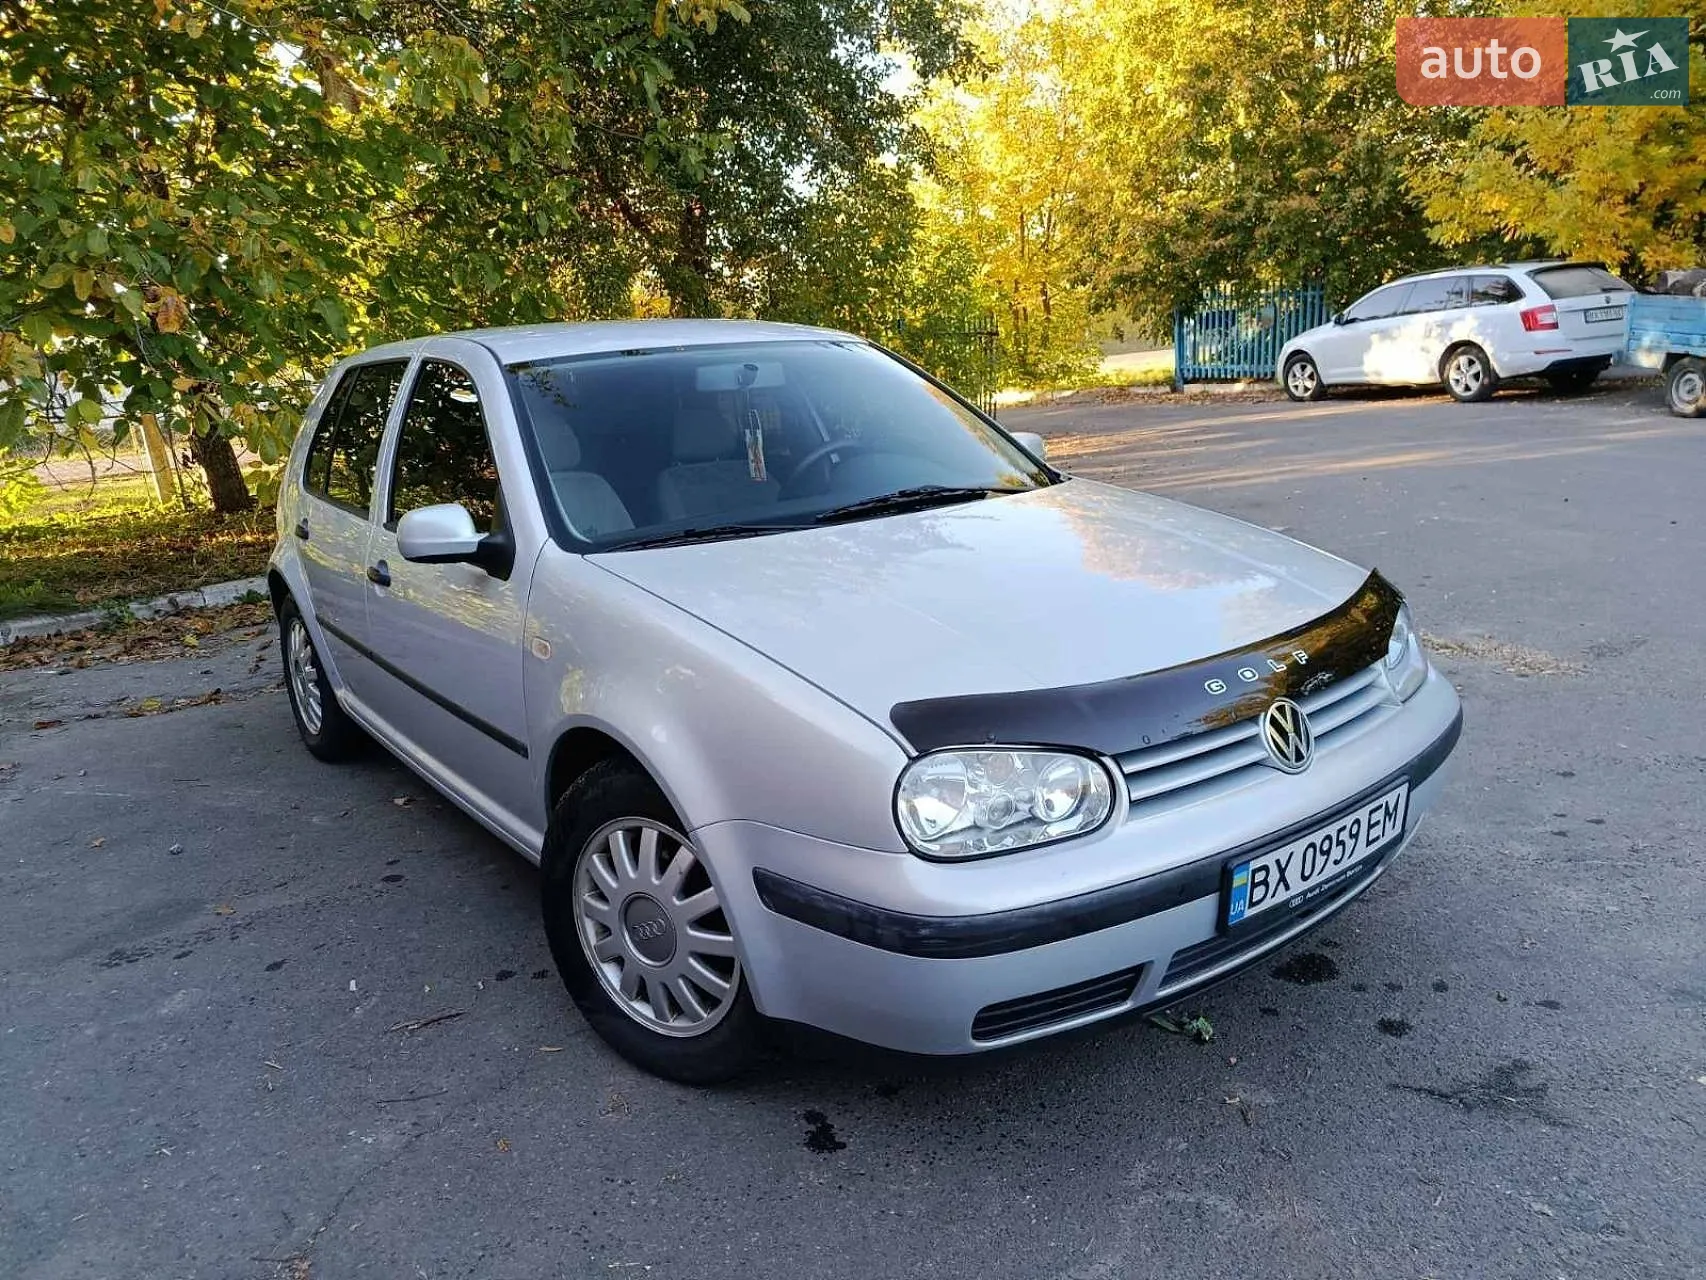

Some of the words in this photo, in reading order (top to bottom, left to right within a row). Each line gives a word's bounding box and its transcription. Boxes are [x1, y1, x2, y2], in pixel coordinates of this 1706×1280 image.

[1204, 649, 1310, 695] GOLF
[1247, 851, 1294, 910] BX
[1300, 817, 1362, 883] 0959
[1365, 792, 1401, 849] EM
[1230, 898, 1245, 914] UA
